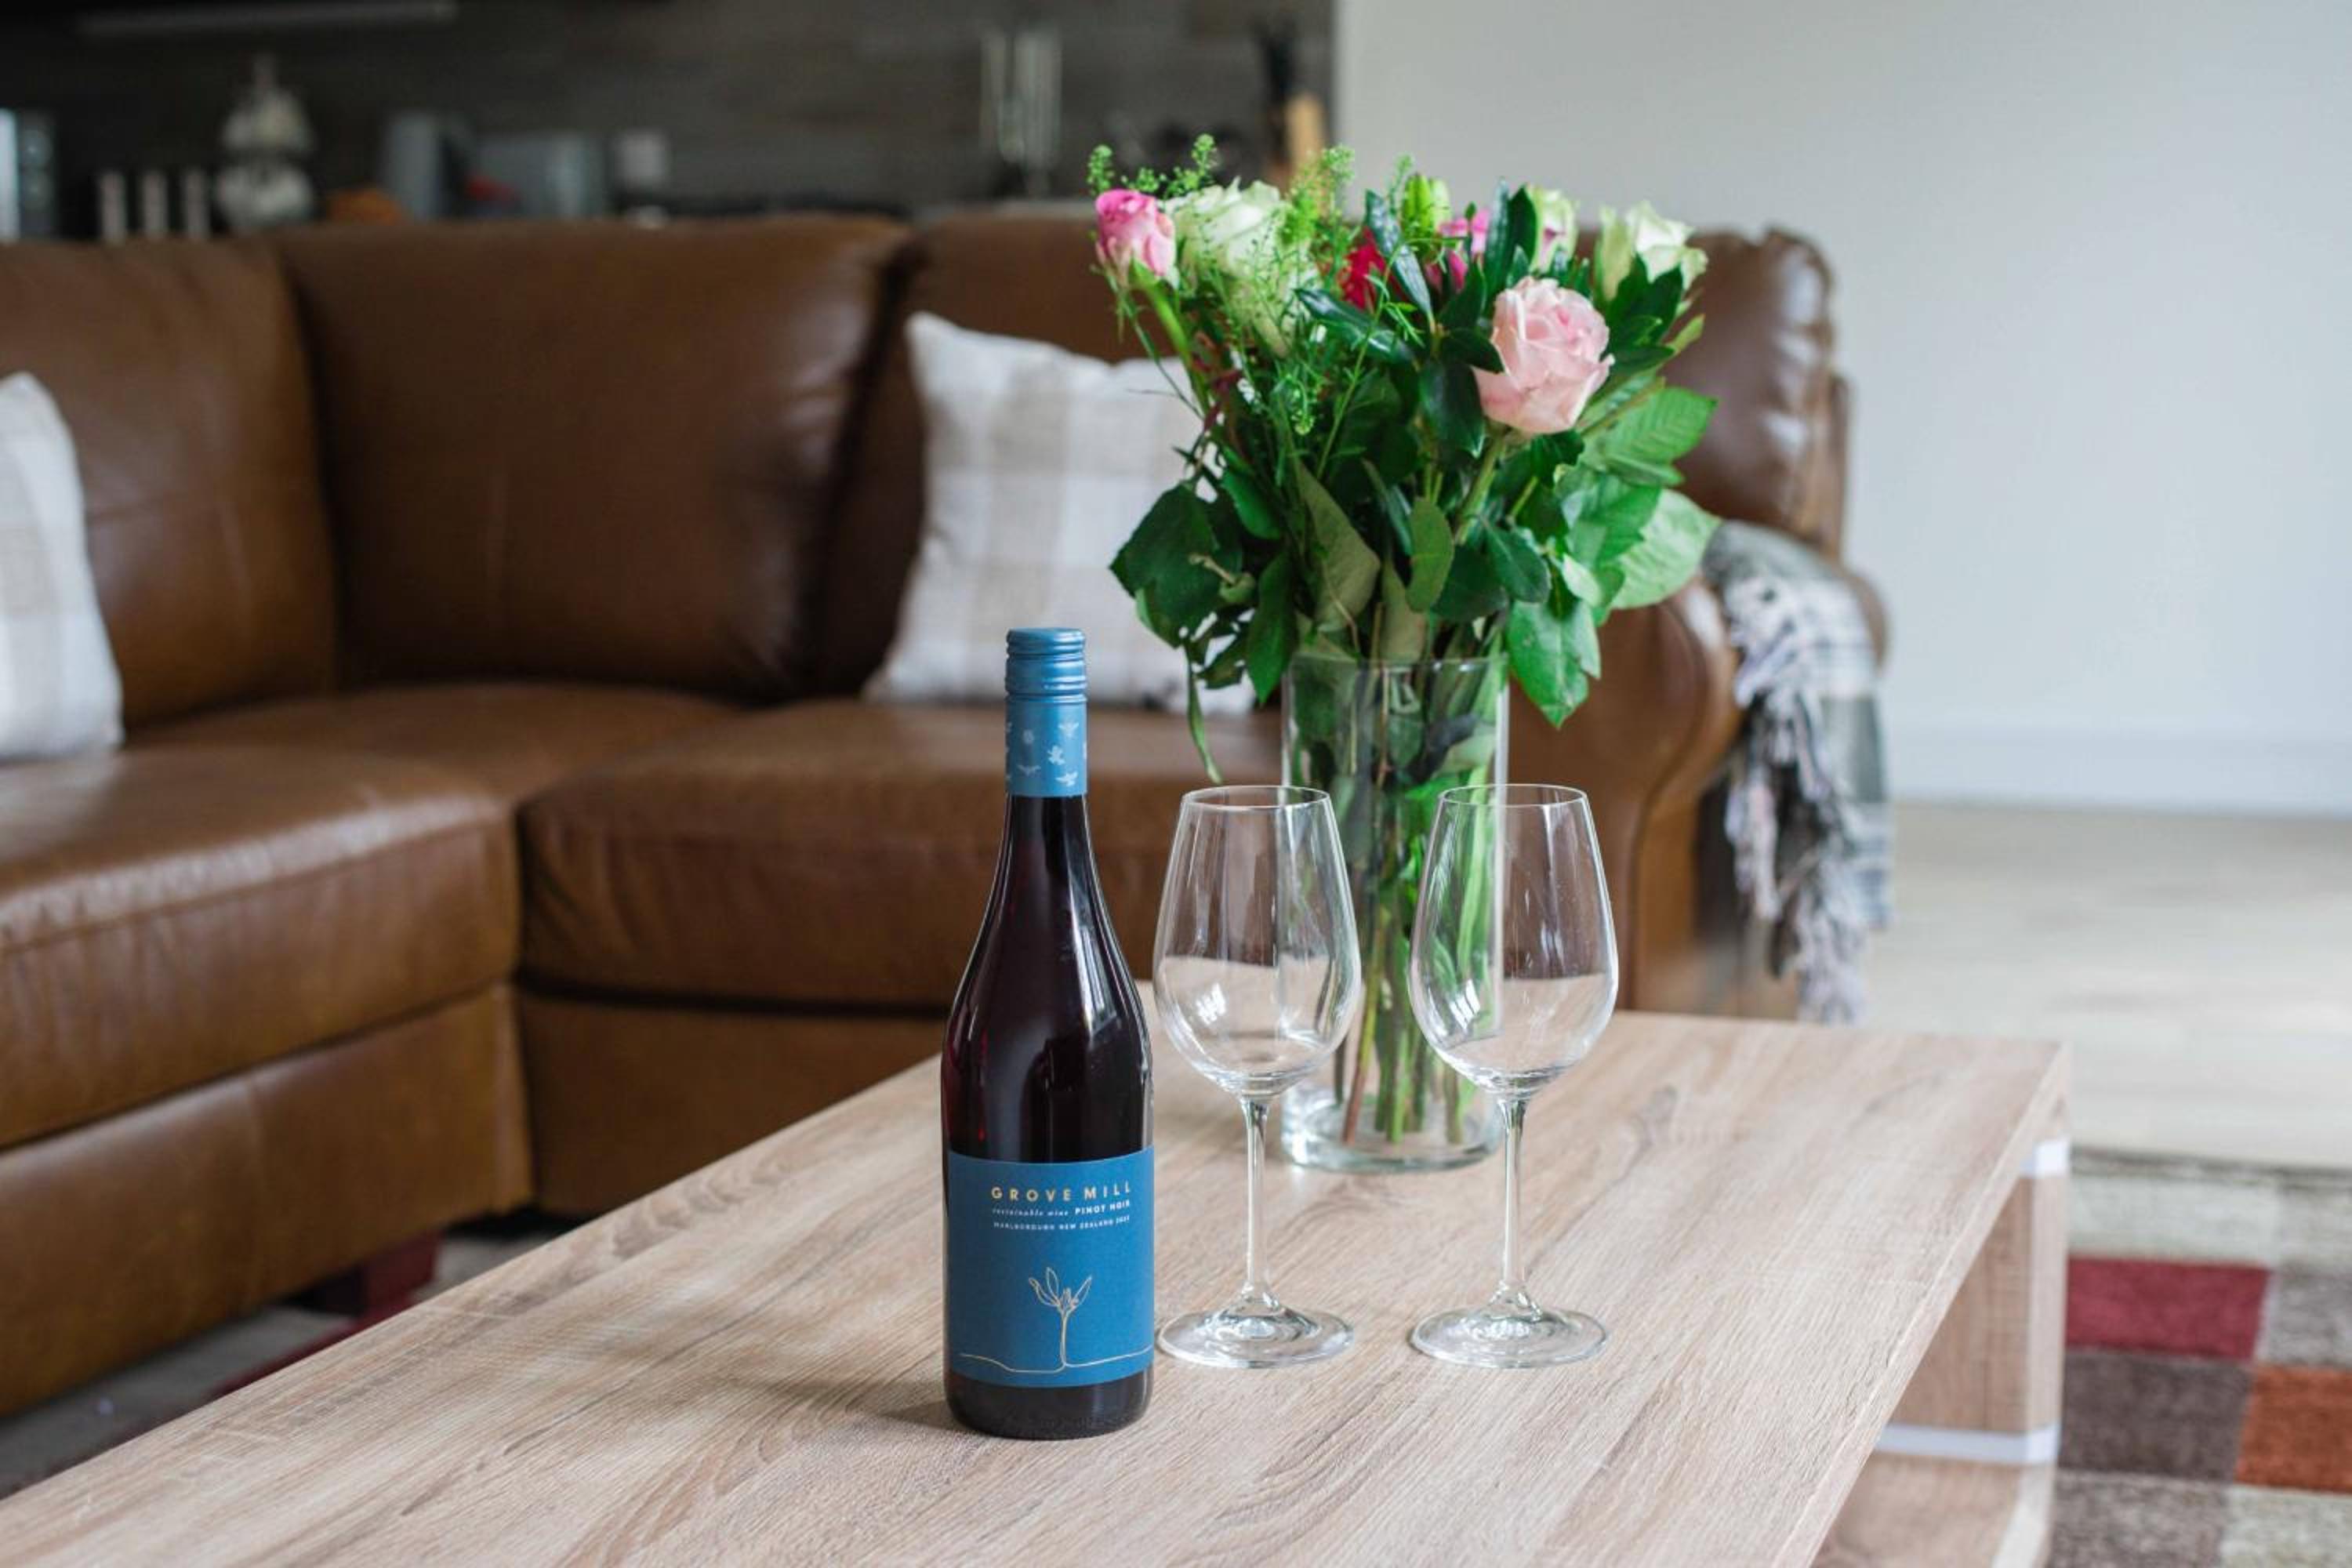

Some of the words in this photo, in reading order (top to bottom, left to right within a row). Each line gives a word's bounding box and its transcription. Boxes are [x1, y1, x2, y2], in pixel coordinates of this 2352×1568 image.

[991, 1186, 1072, 1202] GROVE
[1083, 1181, 1130, 1200] MILL
[1075, 1204, 1105, 1215] PINOT
[1109, 1199, 1130, 1211] NOIR
